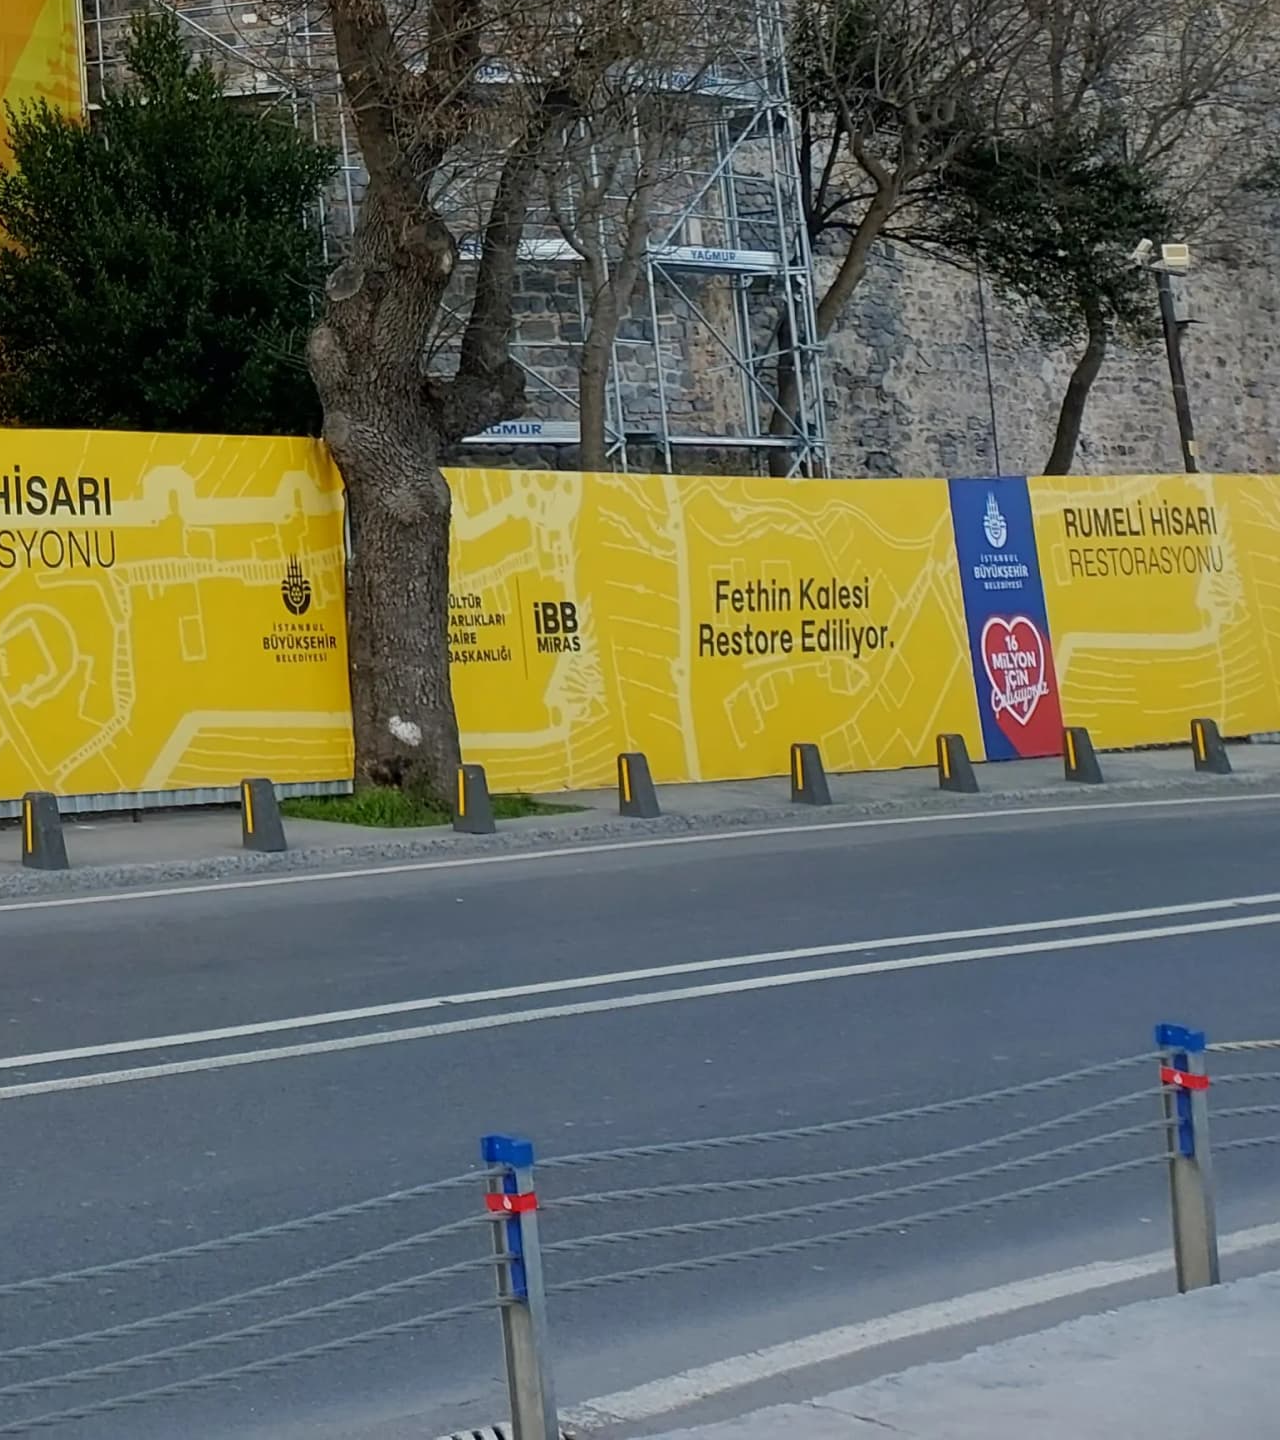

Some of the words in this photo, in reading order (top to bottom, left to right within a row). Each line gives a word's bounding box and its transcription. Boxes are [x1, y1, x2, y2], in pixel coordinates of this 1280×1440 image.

[1063, 499, 1146, 538] RUMELİ
[1149, 499, 1218, 536] HİSARI
[1069, 545, 1224, 577] RESTORASYONU
[973, 563, 1029, 579] BÜYÜKŞEHİR
[448, 593, 482, 609] ÜLTÜR
[715, 578, 791, 614] Fethin
[799, 576, 870, 611] Kalesi
[448, 614, 506, 627] ARLIKLARI
[262, 633, 337, 651] BÜYÜKŞEHİR
[699, 623, 793, 657] Restore
[801, 618, 895, 659] Ediliyor.
[1004, 634, 1019, 651] 16
